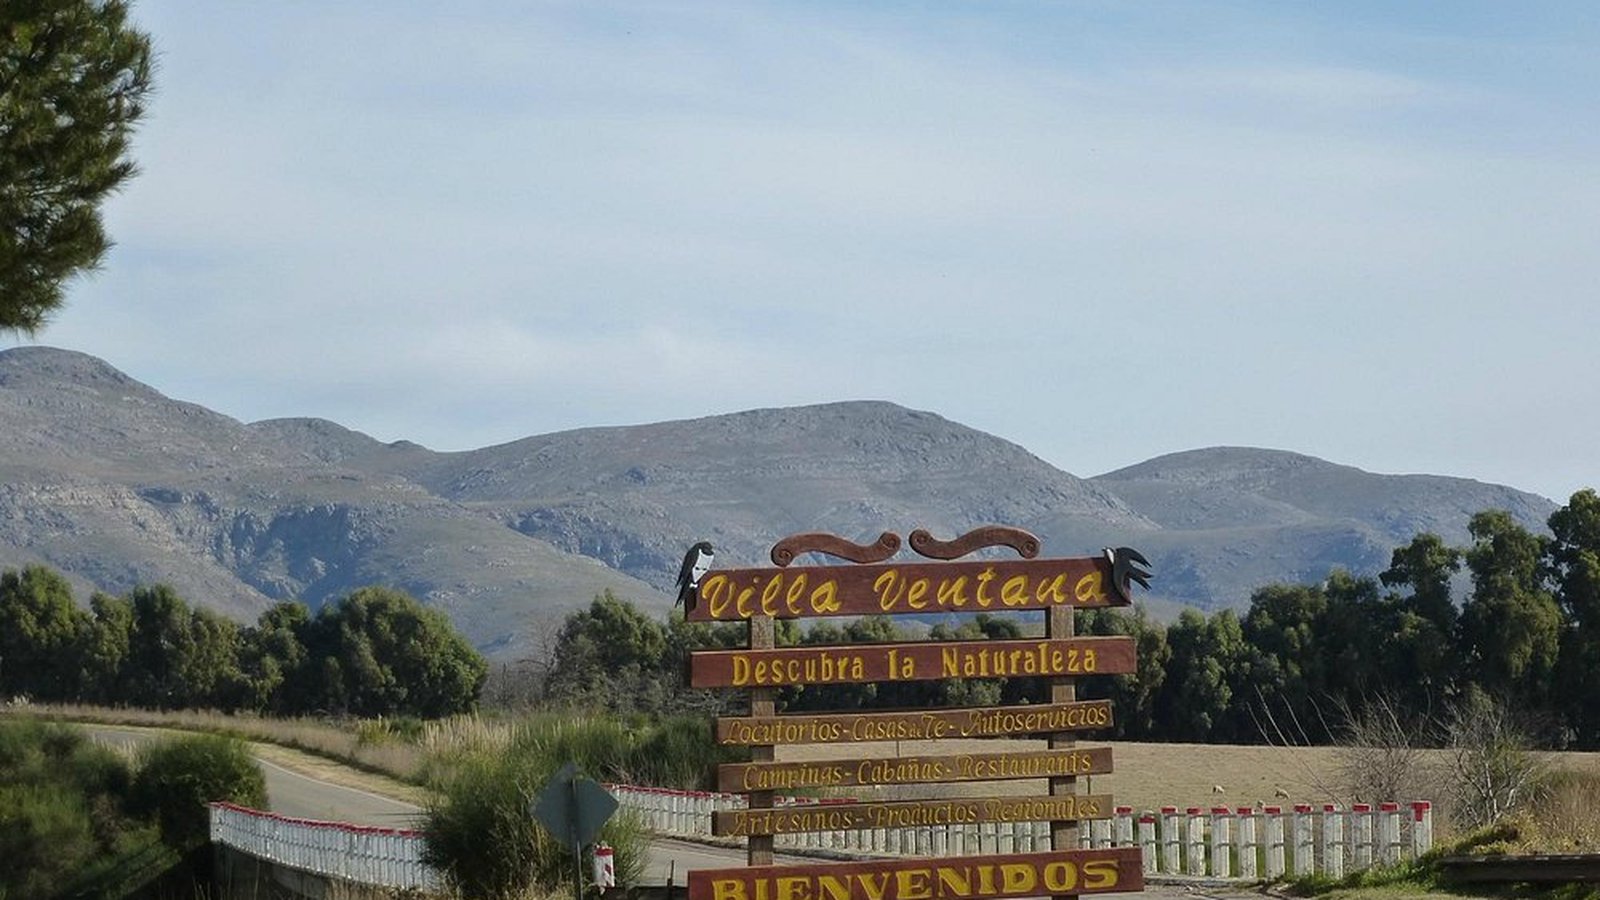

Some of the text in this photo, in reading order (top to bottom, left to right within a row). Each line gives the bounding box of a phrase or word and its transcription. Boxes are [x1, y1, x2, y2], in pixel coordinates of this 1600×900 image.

[702, 567, 1107, 618] Villa Ventana
[732, 643, 1097, 686] Descubra la Naturaleza
[961, 704, 1107, 736] Autoservicios
[955, 753, 1092, 780] Restaurants
[867, 803, 977, 828] Productos
[983, 798, 1099, 823] Regionales
[711, 859, 1119, 900] BIENVENIDOS
